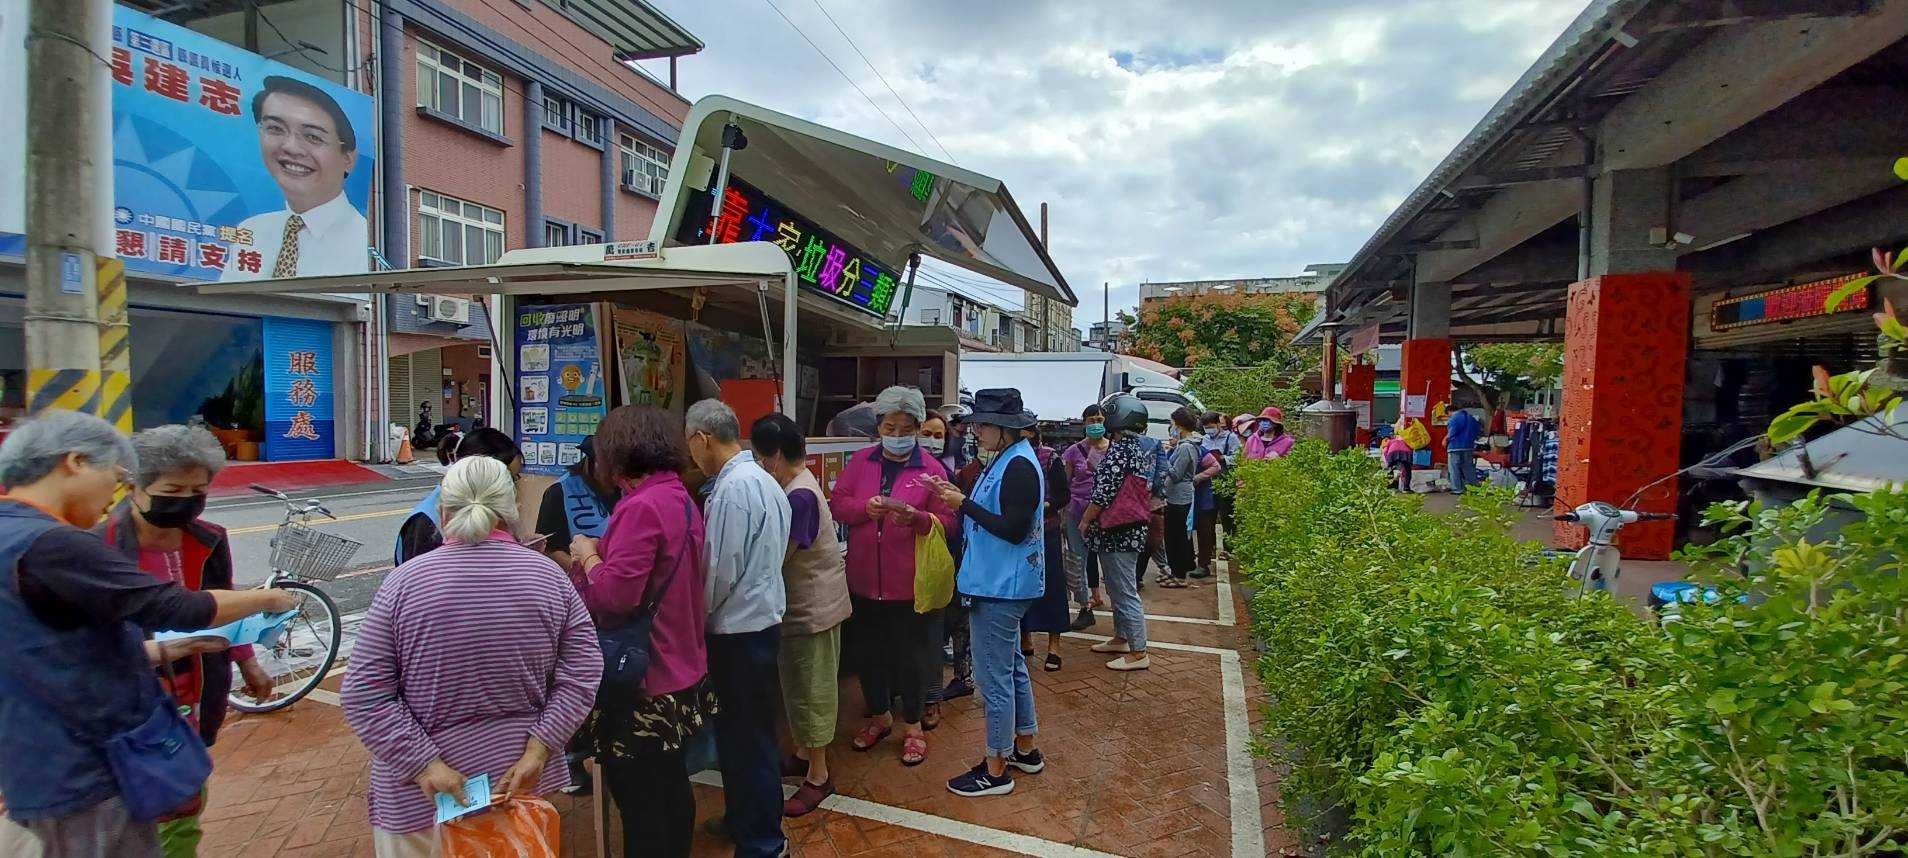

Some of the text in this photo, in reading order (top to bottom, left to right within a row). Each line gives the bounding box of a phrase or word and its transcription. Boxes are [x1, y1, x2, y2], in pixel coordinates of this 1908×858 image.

[116, 229, 262, 273] 懇請支持
[218, 225, 253, 246] 提名
[284, 351, 320, 440] 服務處
